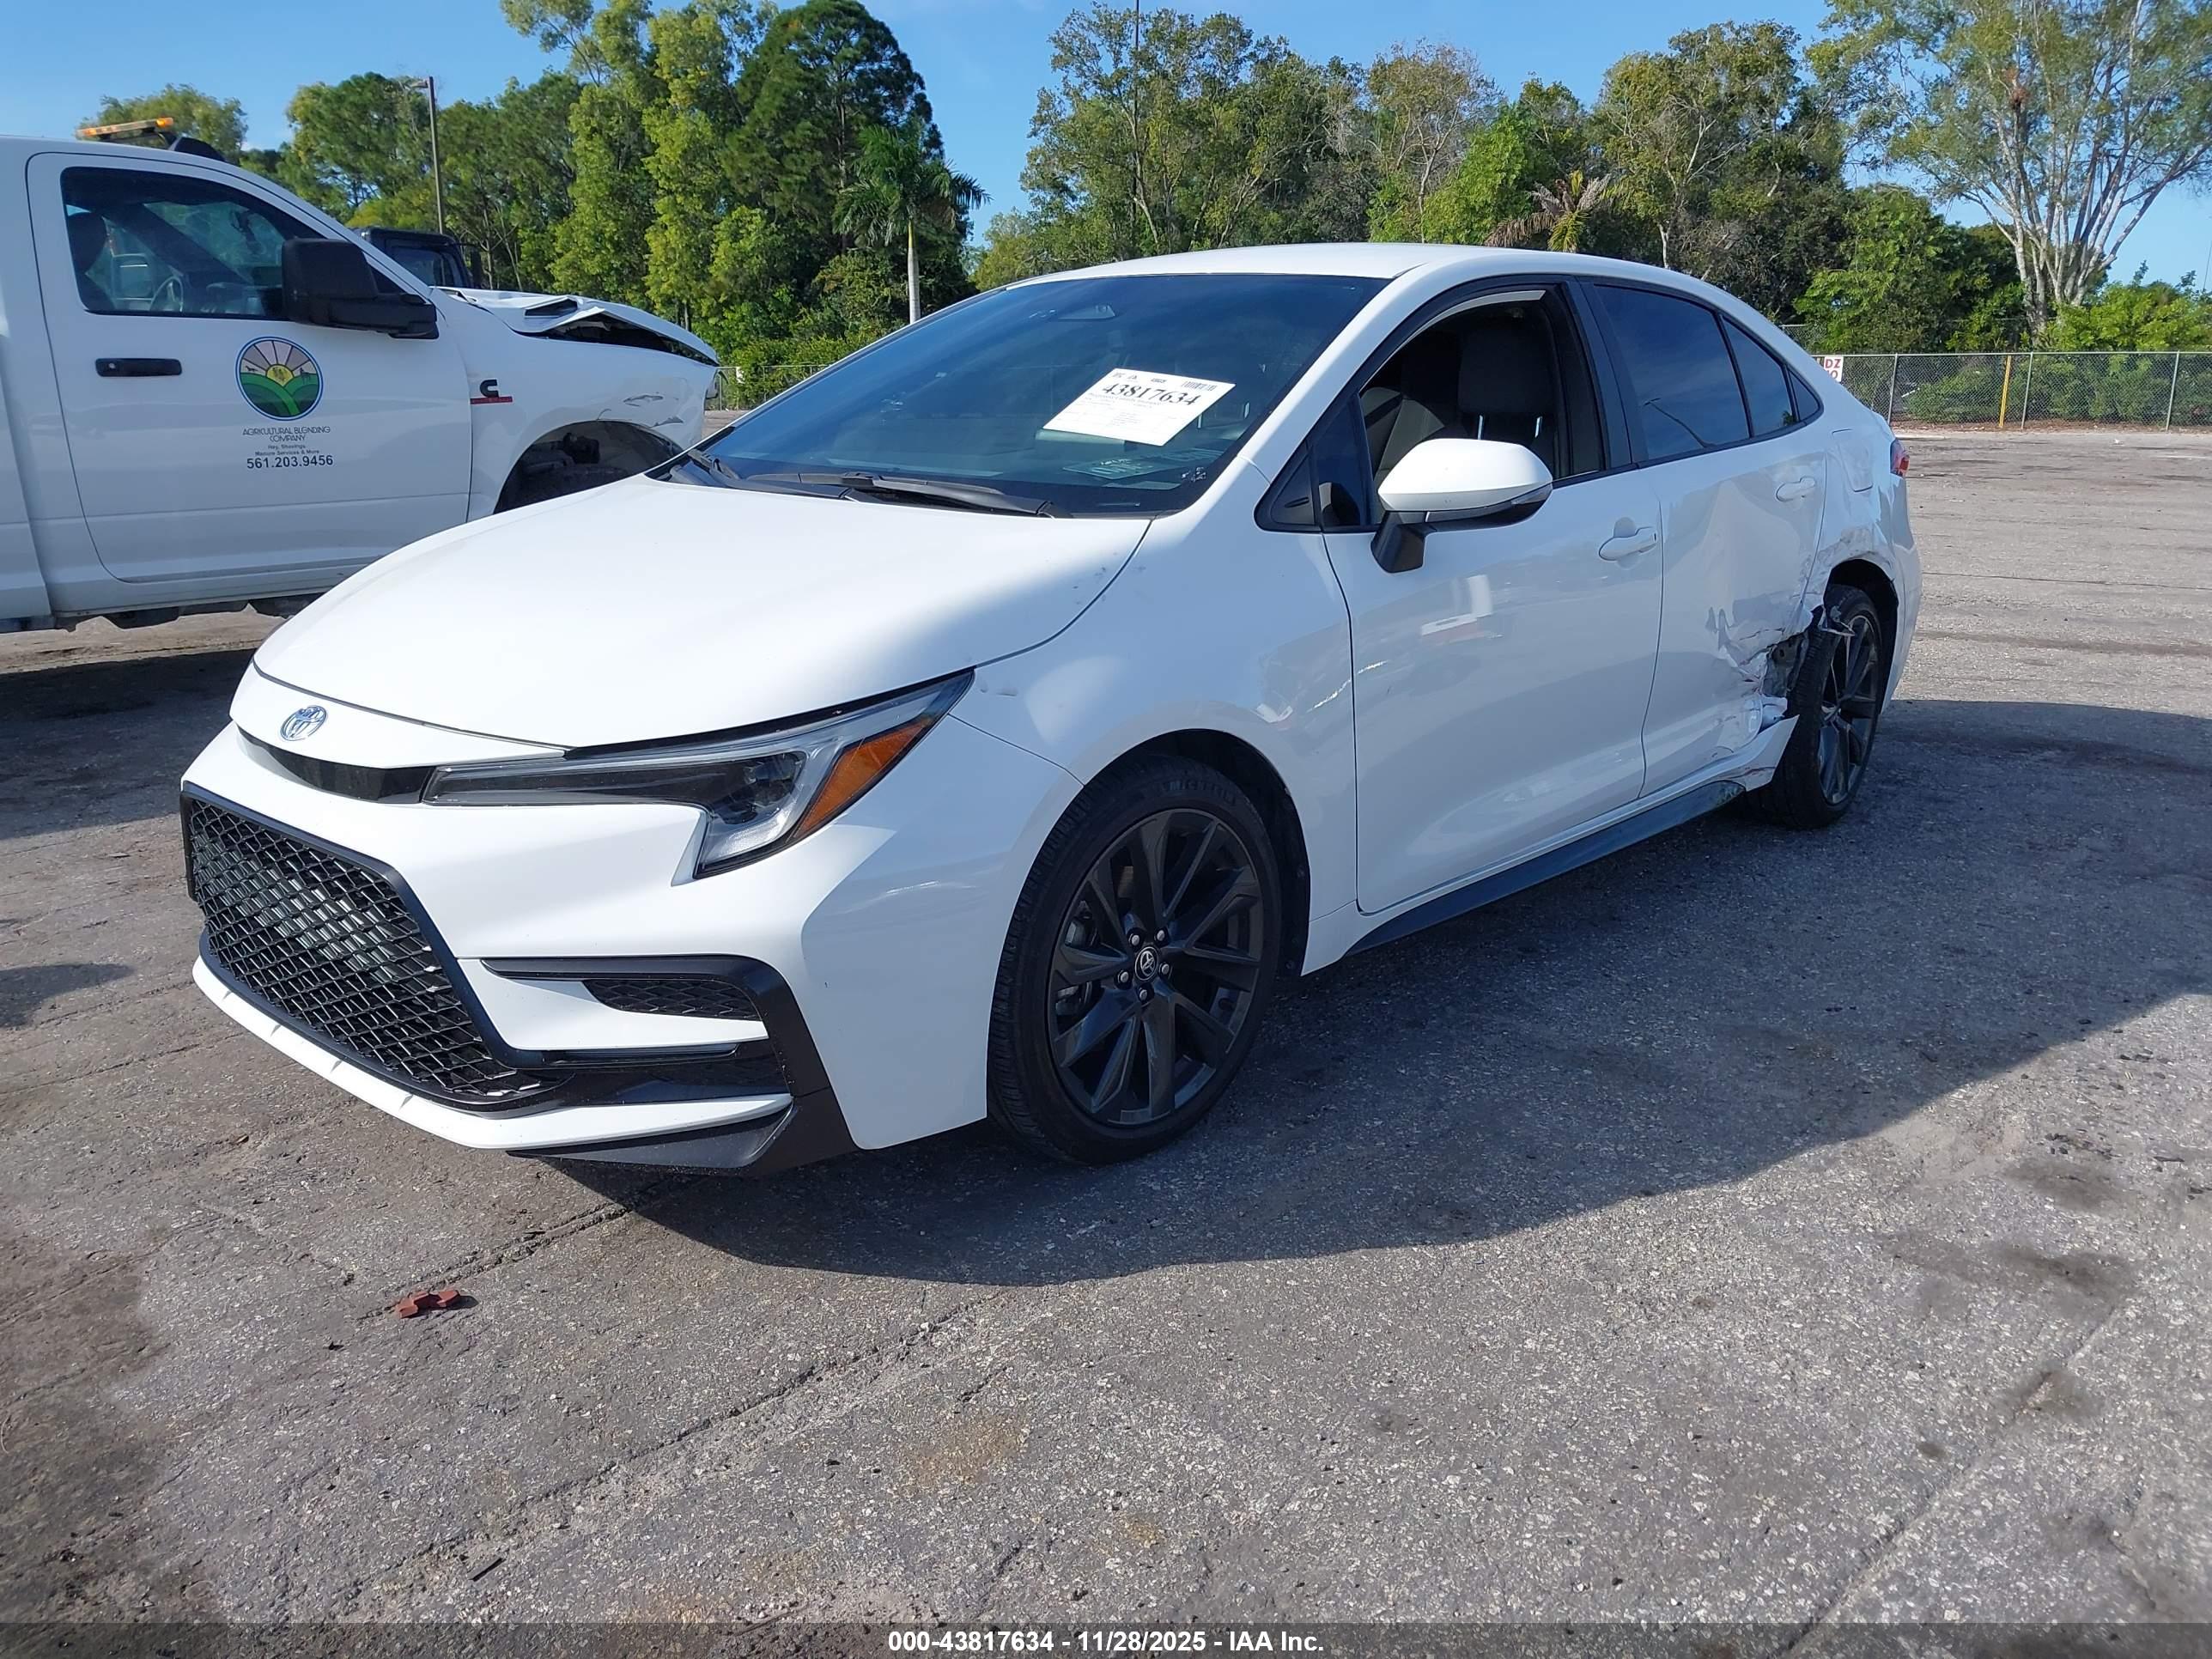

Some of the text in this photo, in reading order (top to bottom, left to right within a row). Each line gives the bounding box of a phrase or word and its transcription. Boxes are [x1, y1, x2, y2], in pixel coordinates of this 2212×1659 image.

[1825, 358, 1841, 368] DZ
[1103, 383, 1201, 405] 43817634
[242, 427, 293, 435] AGRICULTURAL
[246, 455, 333, 469] 561.203.9456
